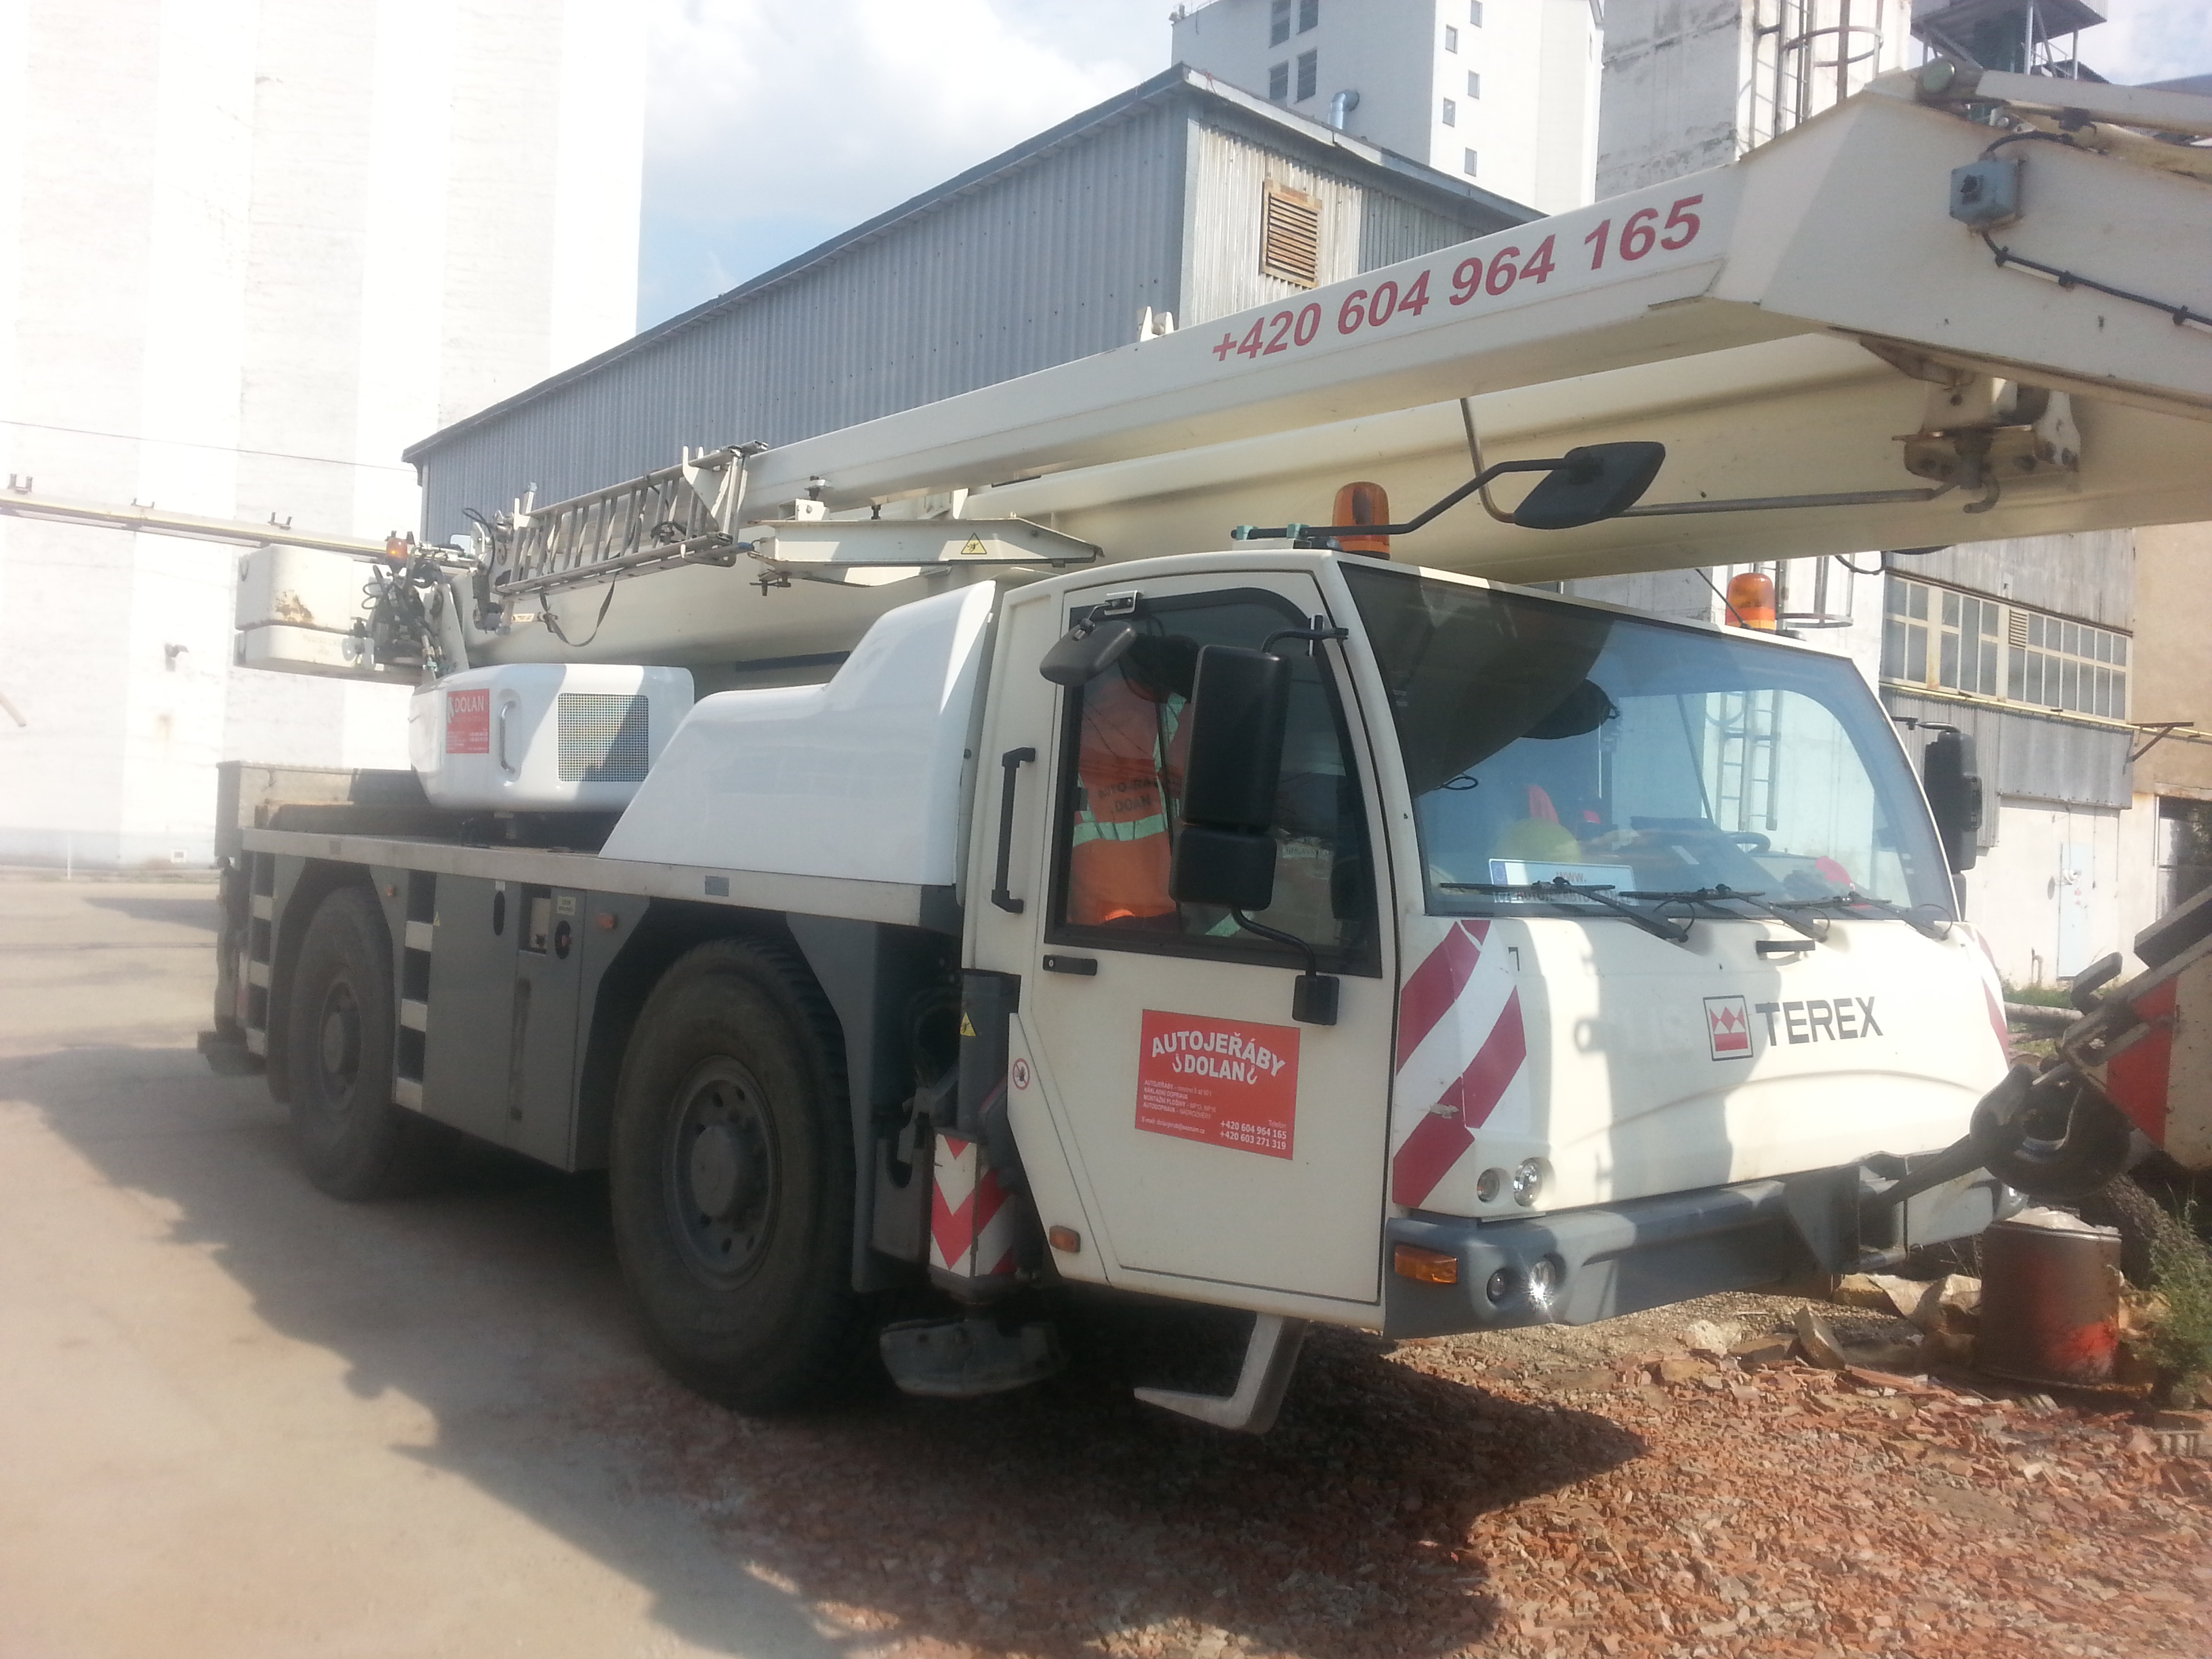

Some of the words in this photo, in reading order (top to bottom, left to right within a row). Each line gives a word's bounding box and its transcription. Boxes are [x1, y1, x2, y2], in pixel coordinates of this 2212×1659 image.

[1212, 302, 1322, 361] +420
[1338, 270, 1431, 335] 604
[1449, 234, 1556, 306] 964
[1584, 194, 1703, 270] 165
[455, 695, 484, 713] DOLAN
[1755, 996, 1883, 1046] TEREX
[1152, 1031, 1286, 1077] AUTOJEŘÁBY
[1184, 1054, 1245, 1082] DOLAN
[1220, 1131, 1239, 1141] +420
[1241, 1134, 1254, 1144] 603
[1256, 1136, 1270, 1147] 271
[1272, 1140, 1286, 1150] 319
[1221, 1120, 1239, 1130] +420
[1241, 1124, 1255, 1133] 604
[1257, 1126, 1271, 1136] 964
[1273, 1130, 1287, 1139] 165
